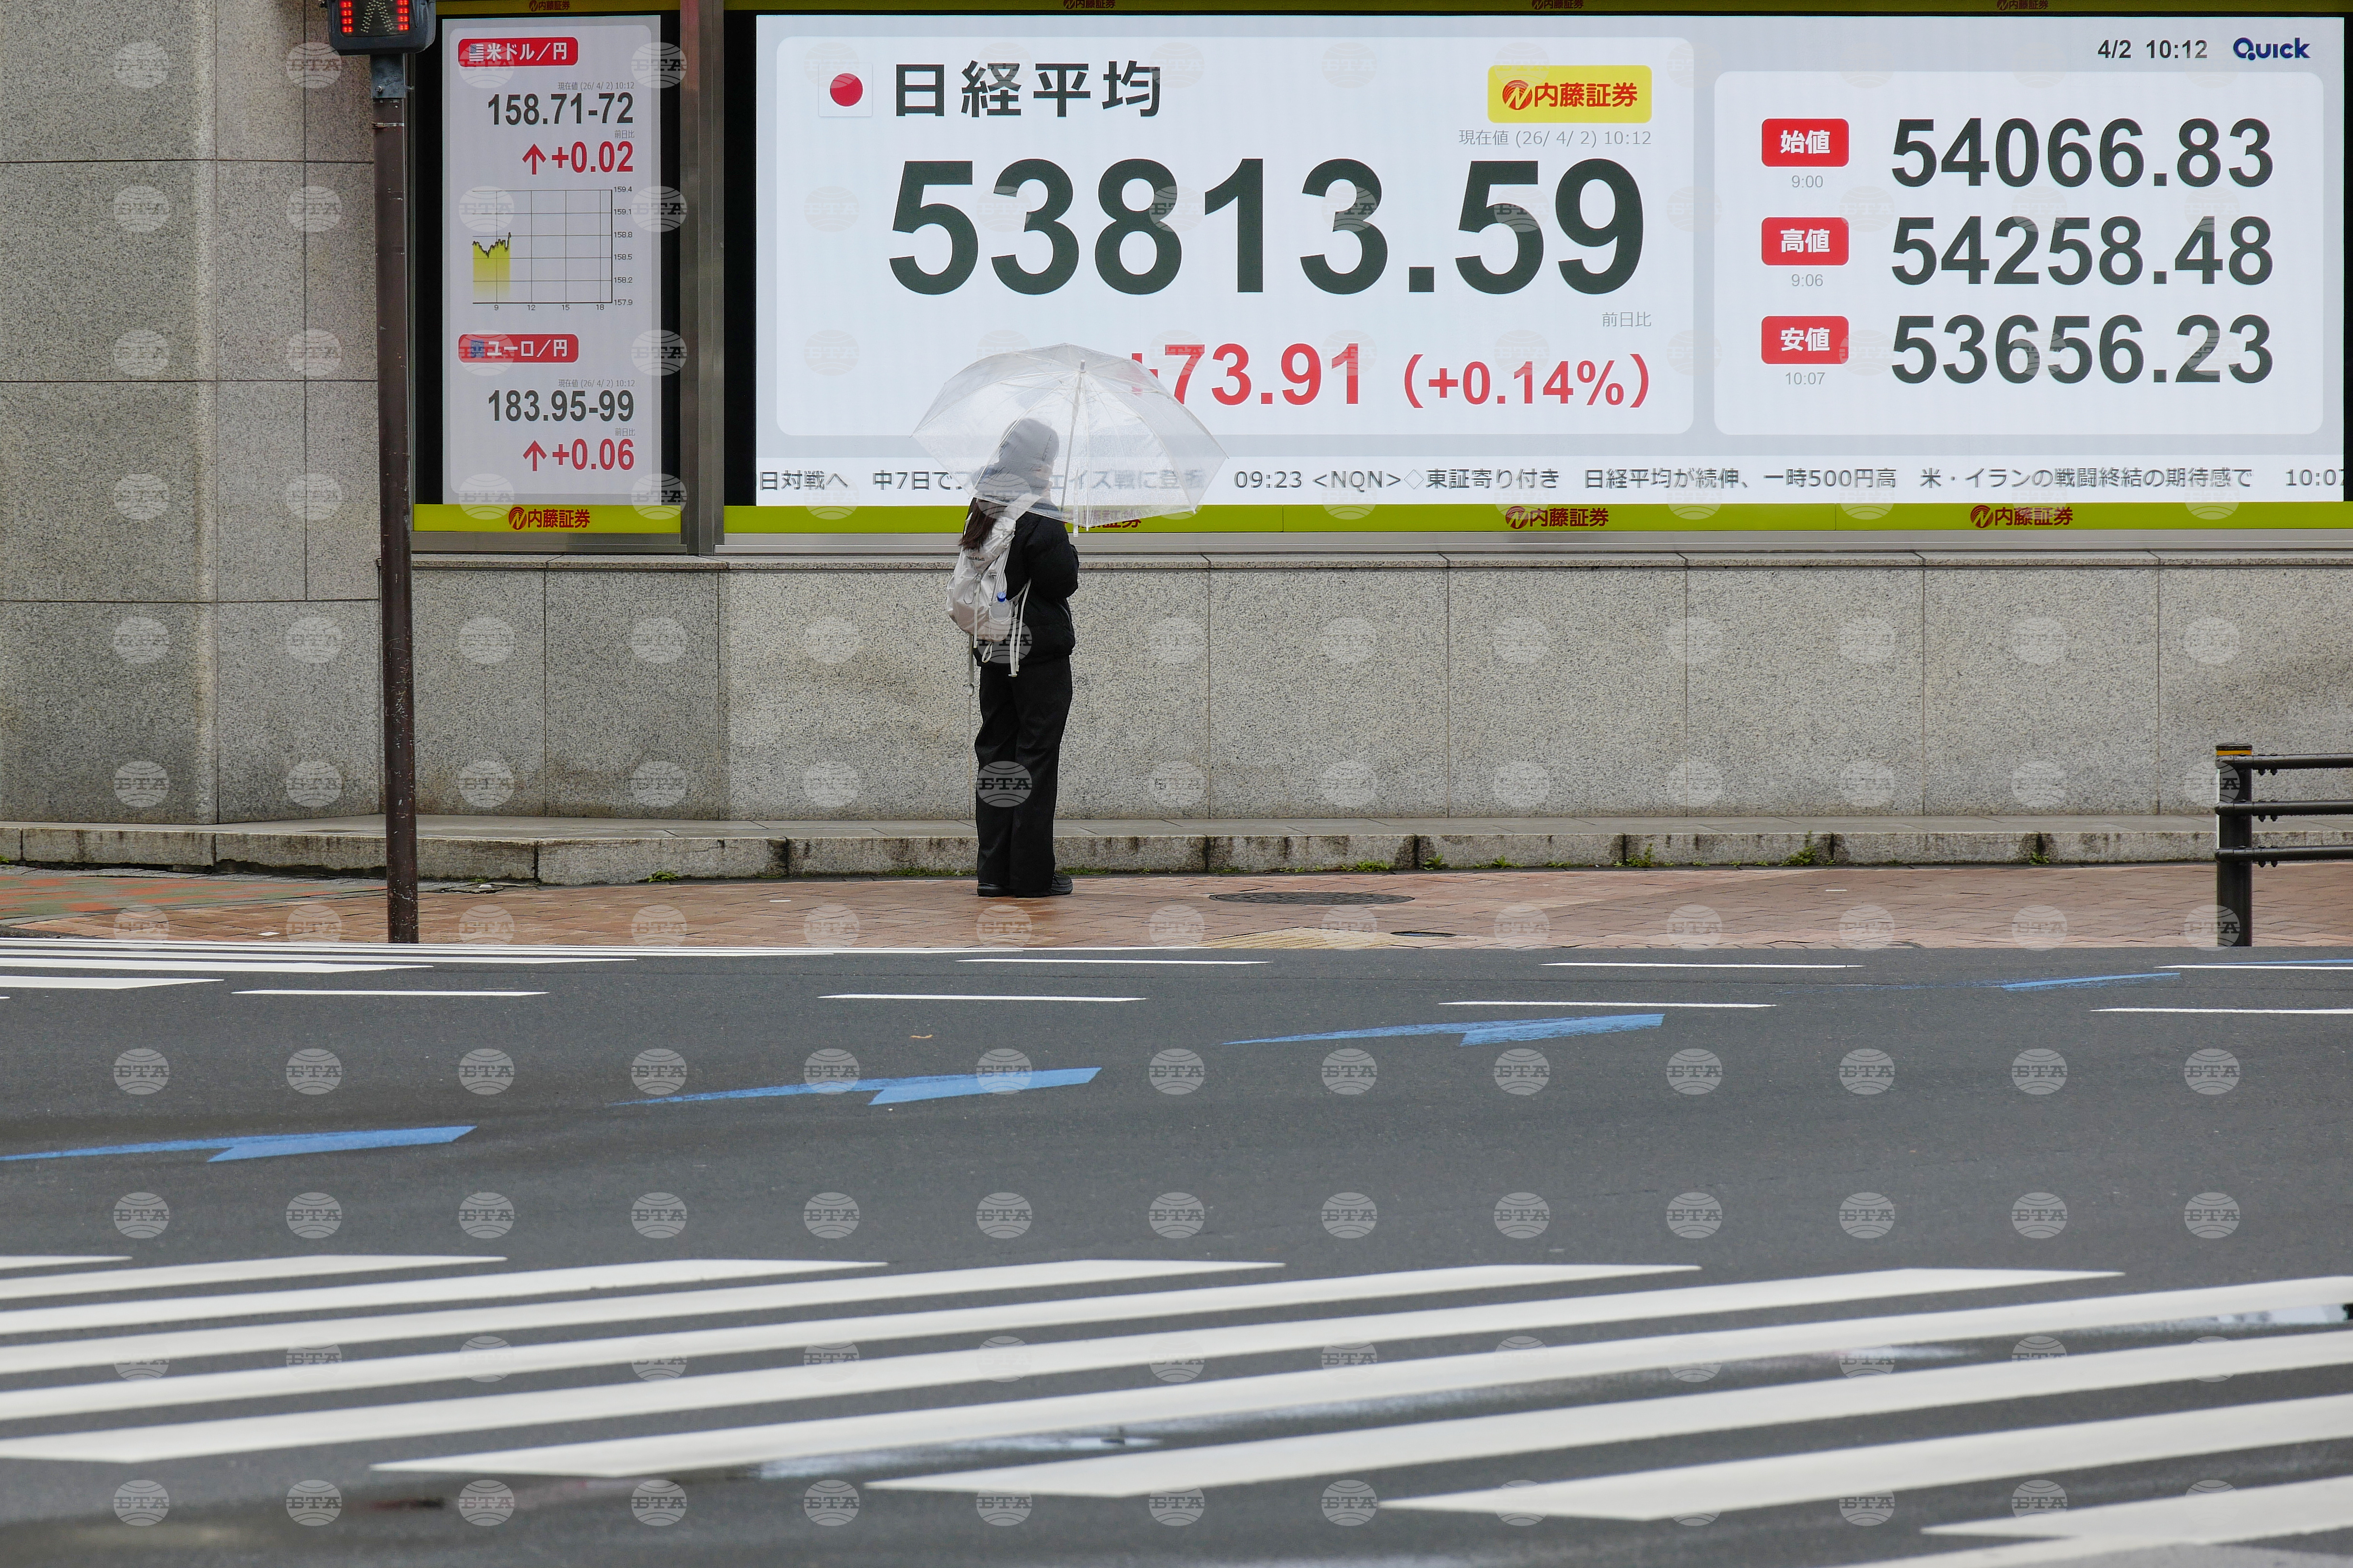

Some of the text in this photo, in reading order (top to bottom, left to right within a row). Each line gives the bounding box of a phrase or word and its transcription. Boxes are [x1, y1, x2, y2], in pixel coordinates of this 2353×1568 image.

[538, 0, 570, 10] 内藤証券
[2098, 39, 2207, 58] 4/2 10:12
[558, 82, 578, 90] 現在値
[580, 81, 594, 91] (26/
[606, 82, 613, 90] 2)
[615, 81, 634, 89] 10:12
[896, 60, 1160, 117] 日経平均
[1535, 82, 1637, 107] 内藤証券
[488, 92, 633, 125] 158.71-72
[614, 129, 635, 138] 前日比
[1459, 129, 1651, 148] 現在値 (26/ 4/ 2) 10:12
[1780, 130, 1831, 154] 始値
[552, 140, 633, 173] +0.02
[1892, 118, 2273, 187] 54066.83
[1792, 175, 1823, 188] 9:00
[889, 159, 1643, 295] 53813.59
[1780, 229, 1830, 253] 高値
[1891, 216, 2272, 286] 54258.48
[1792, 274, 1823, 287] 9:06
[1602, 311, 1651, 327] 前日比
[1781, 327, 1830, 351] 安値
[1891, 314, 2272, 384] 53656.23
[558, 379, 635, 388] 現在値 (26/ 4/ 2) 10:12
[1404, 354, 1648, 408] (+0.14%)
[1785, 372, 1825, 385] 10:07
[489, 390, 634, 422] 183.95-99
[615, 427, 636, 437] 前日比
[552, 438, 634, 471] +0.06
[760, 470, 848, 491] 日対戦へ
[1234, 471, 1301, 488] 09:23
[528, 509, 590, 528] 内藤証券
[1530, 508, 1609, 527] 内藤証券
[1994, 507, 2074, 527] 内藤証券
